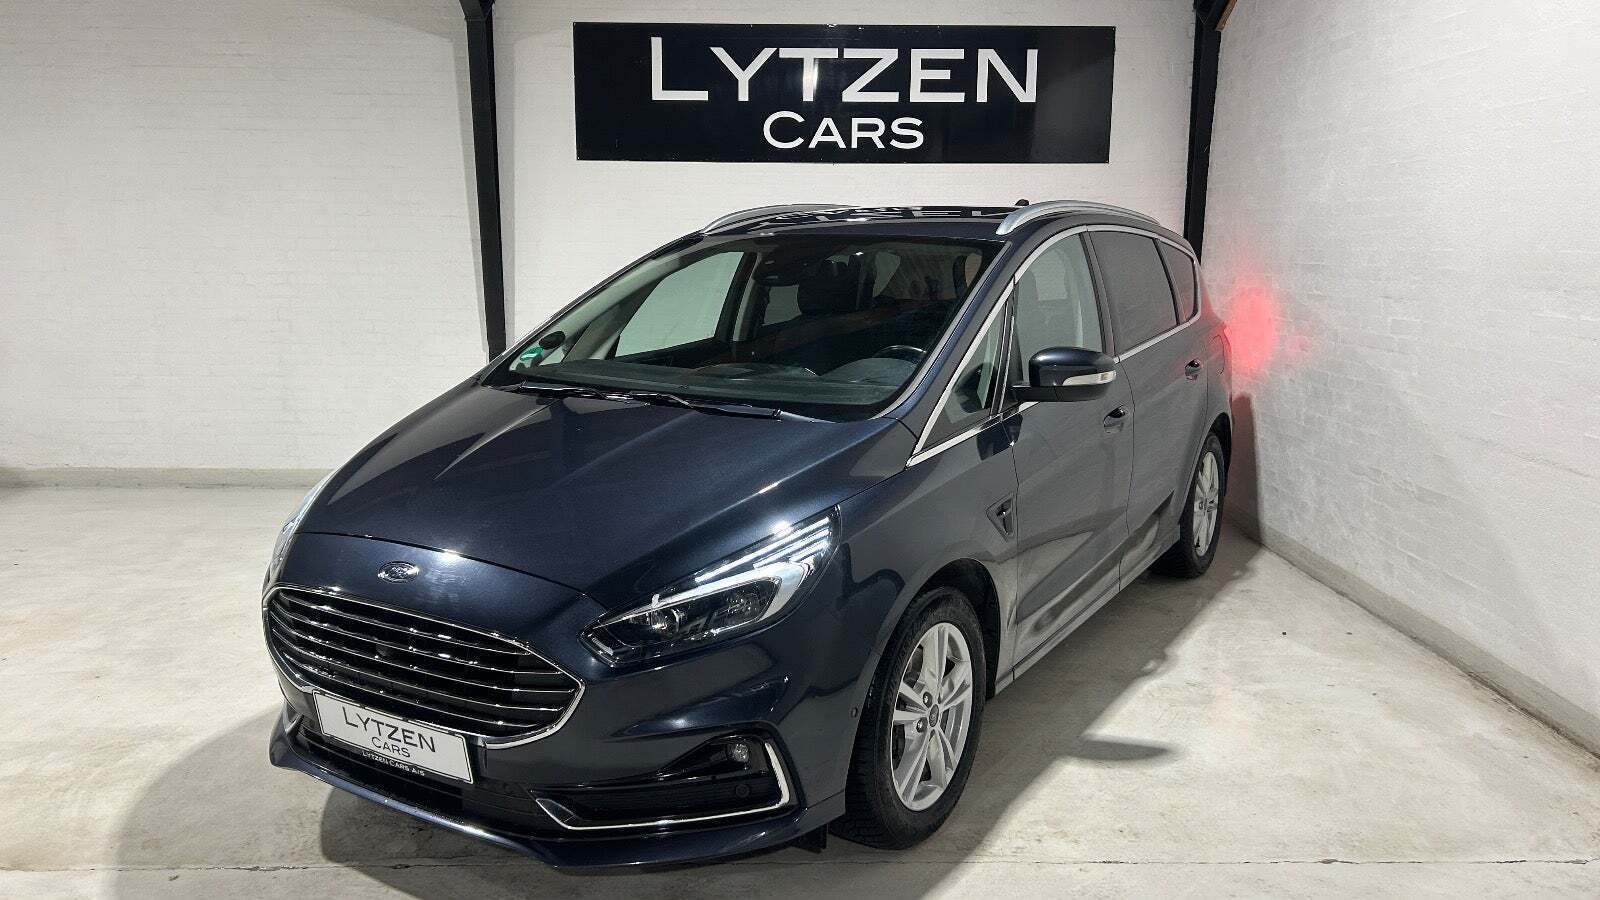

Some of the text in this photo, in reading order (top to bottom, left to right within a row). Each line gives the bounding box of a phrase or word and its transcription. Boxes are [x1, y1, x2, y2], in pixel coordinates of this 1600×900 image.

[651, 37, 1038, 103] LYTZEN
[763, 111, 924, 149] CARS
[342, 706, 436, 753] LYTZEN
[371, 736, 411, 758] CARS
[389, 759, 410, 772] CARS
